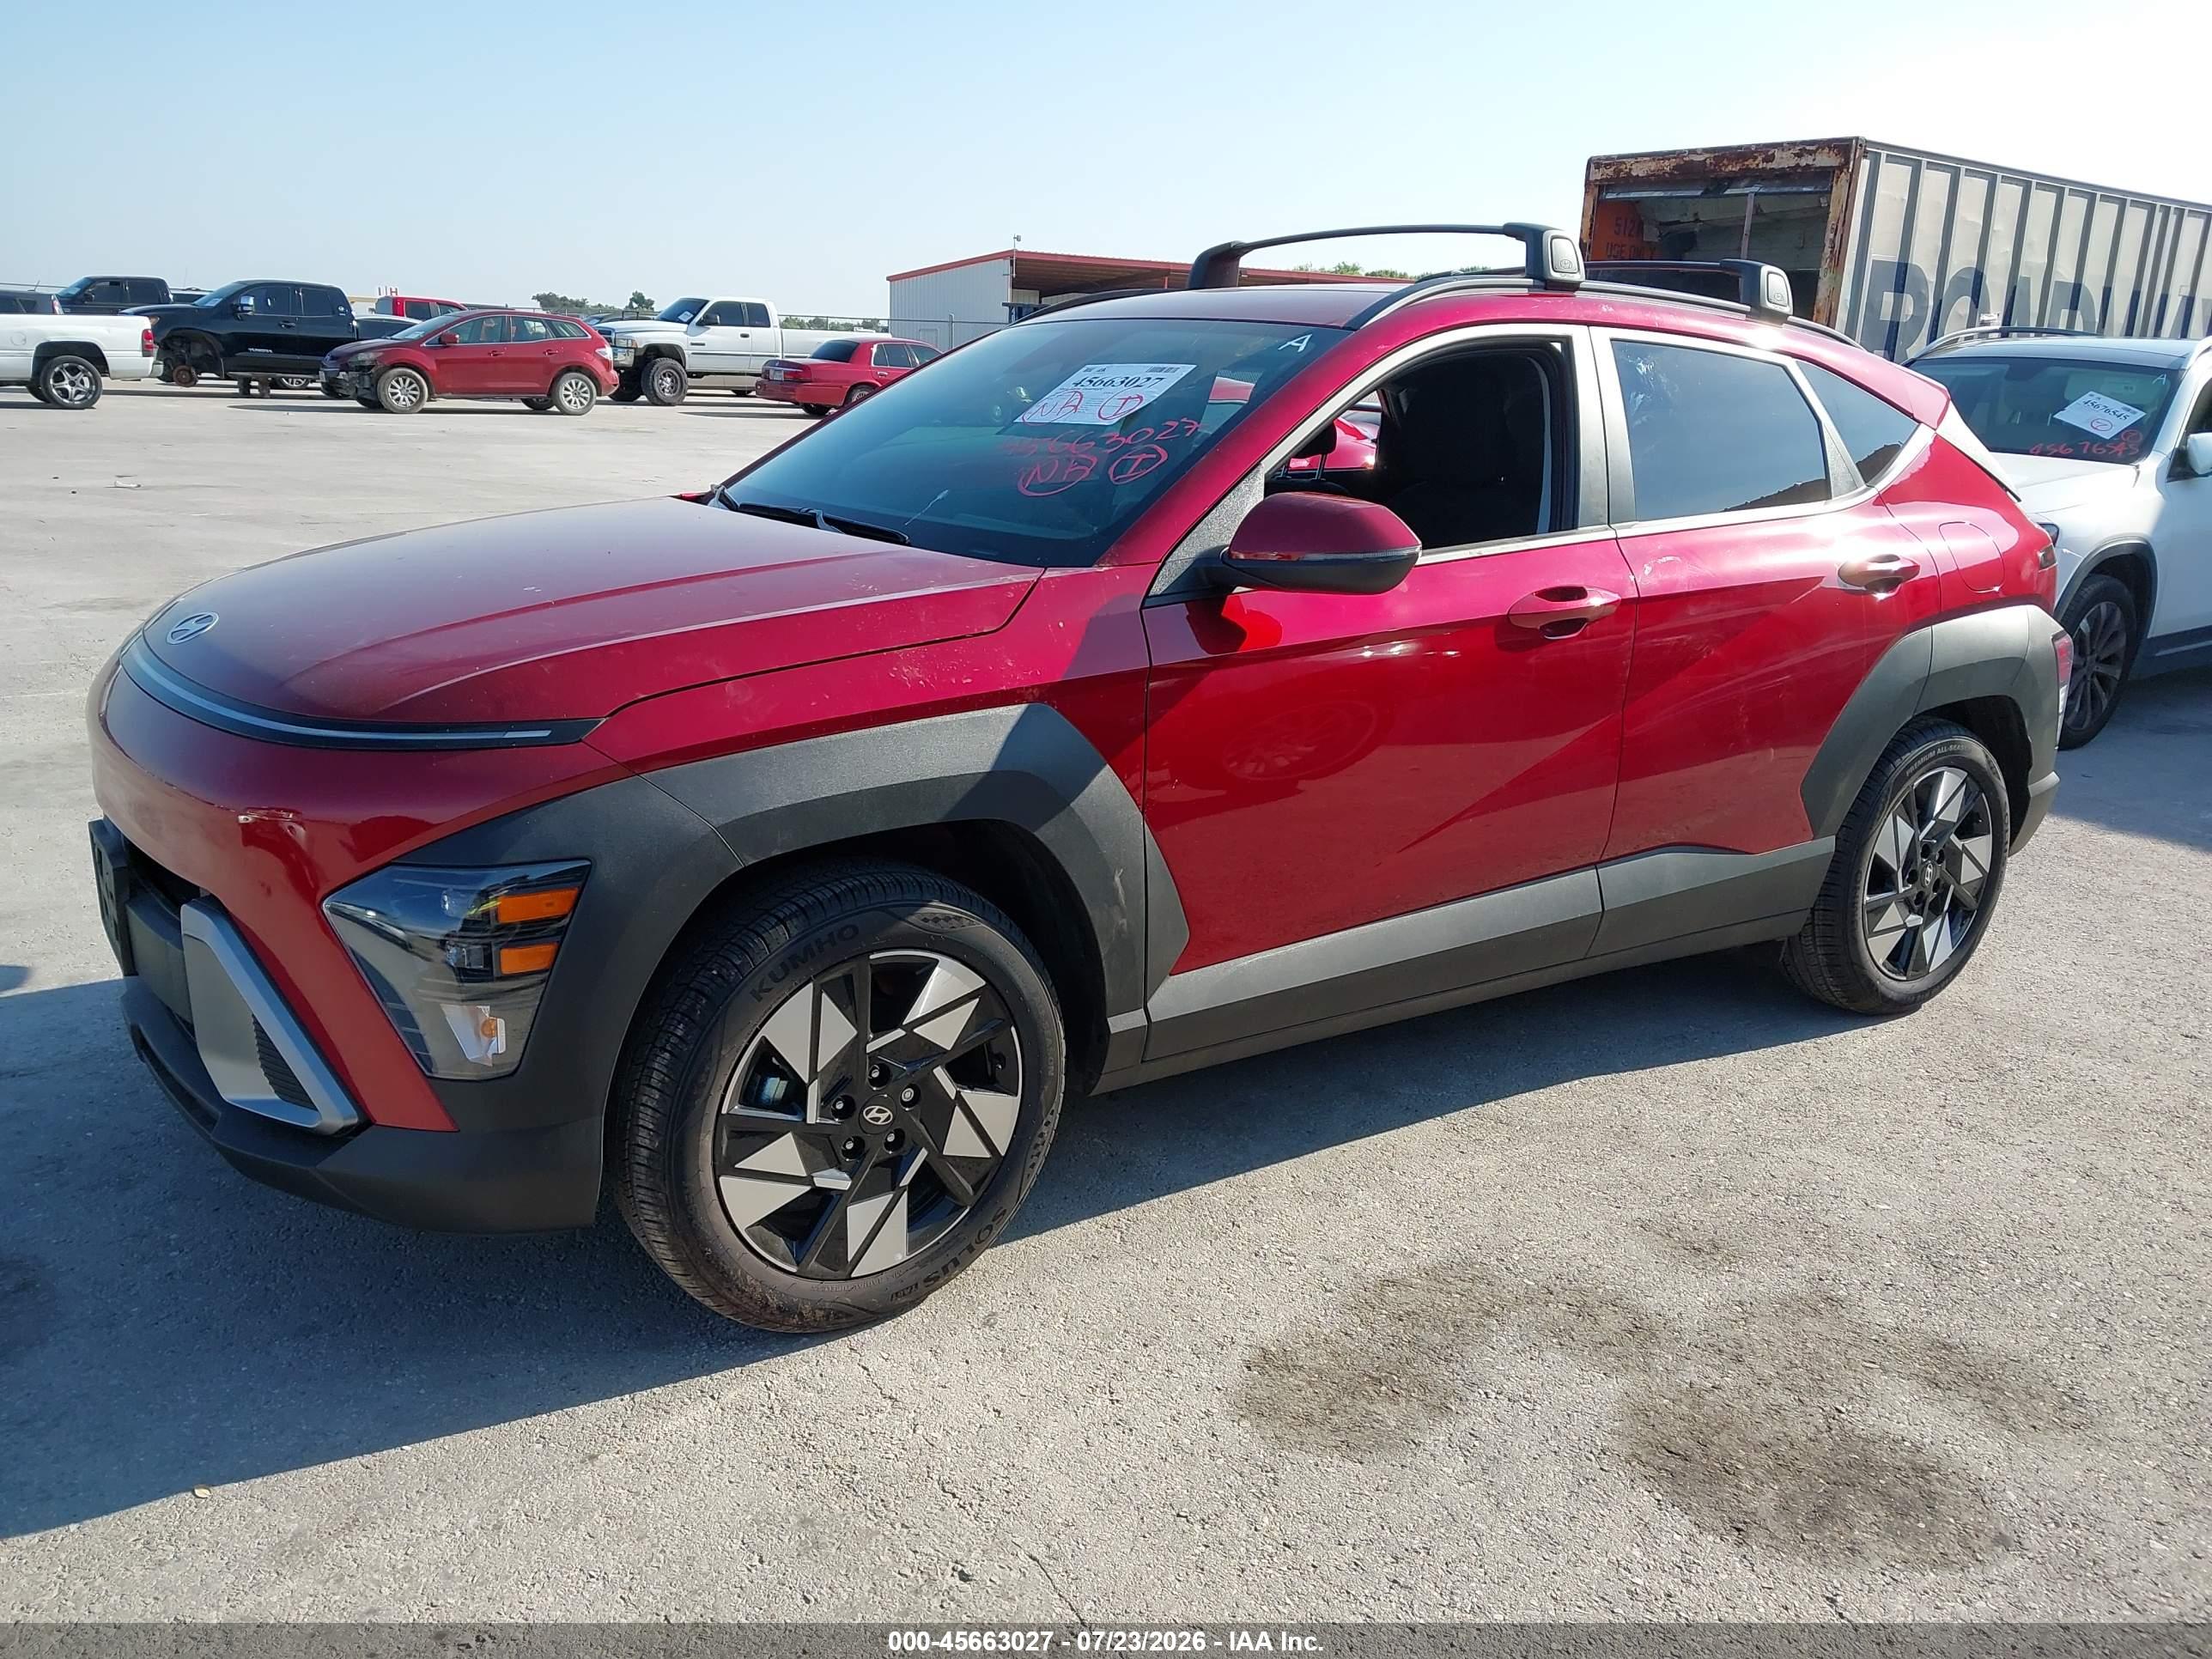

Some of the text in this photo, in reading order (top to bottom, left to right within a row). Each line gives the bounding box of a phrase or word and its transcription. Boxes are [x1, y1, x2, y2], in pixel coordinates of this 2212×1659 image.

[1858, 259, 2212, 364] ROADWA
[1278, 333, 1313, 352] A
[1072, 376, 1166, 389] 45663027
[2152, 374, 2166, 385] A
[2082, 399, 2130, 421] 45676545
[749, 924, 859, 1003] KUMHO
[923, 1206, 1008, 1287] SOLUS
